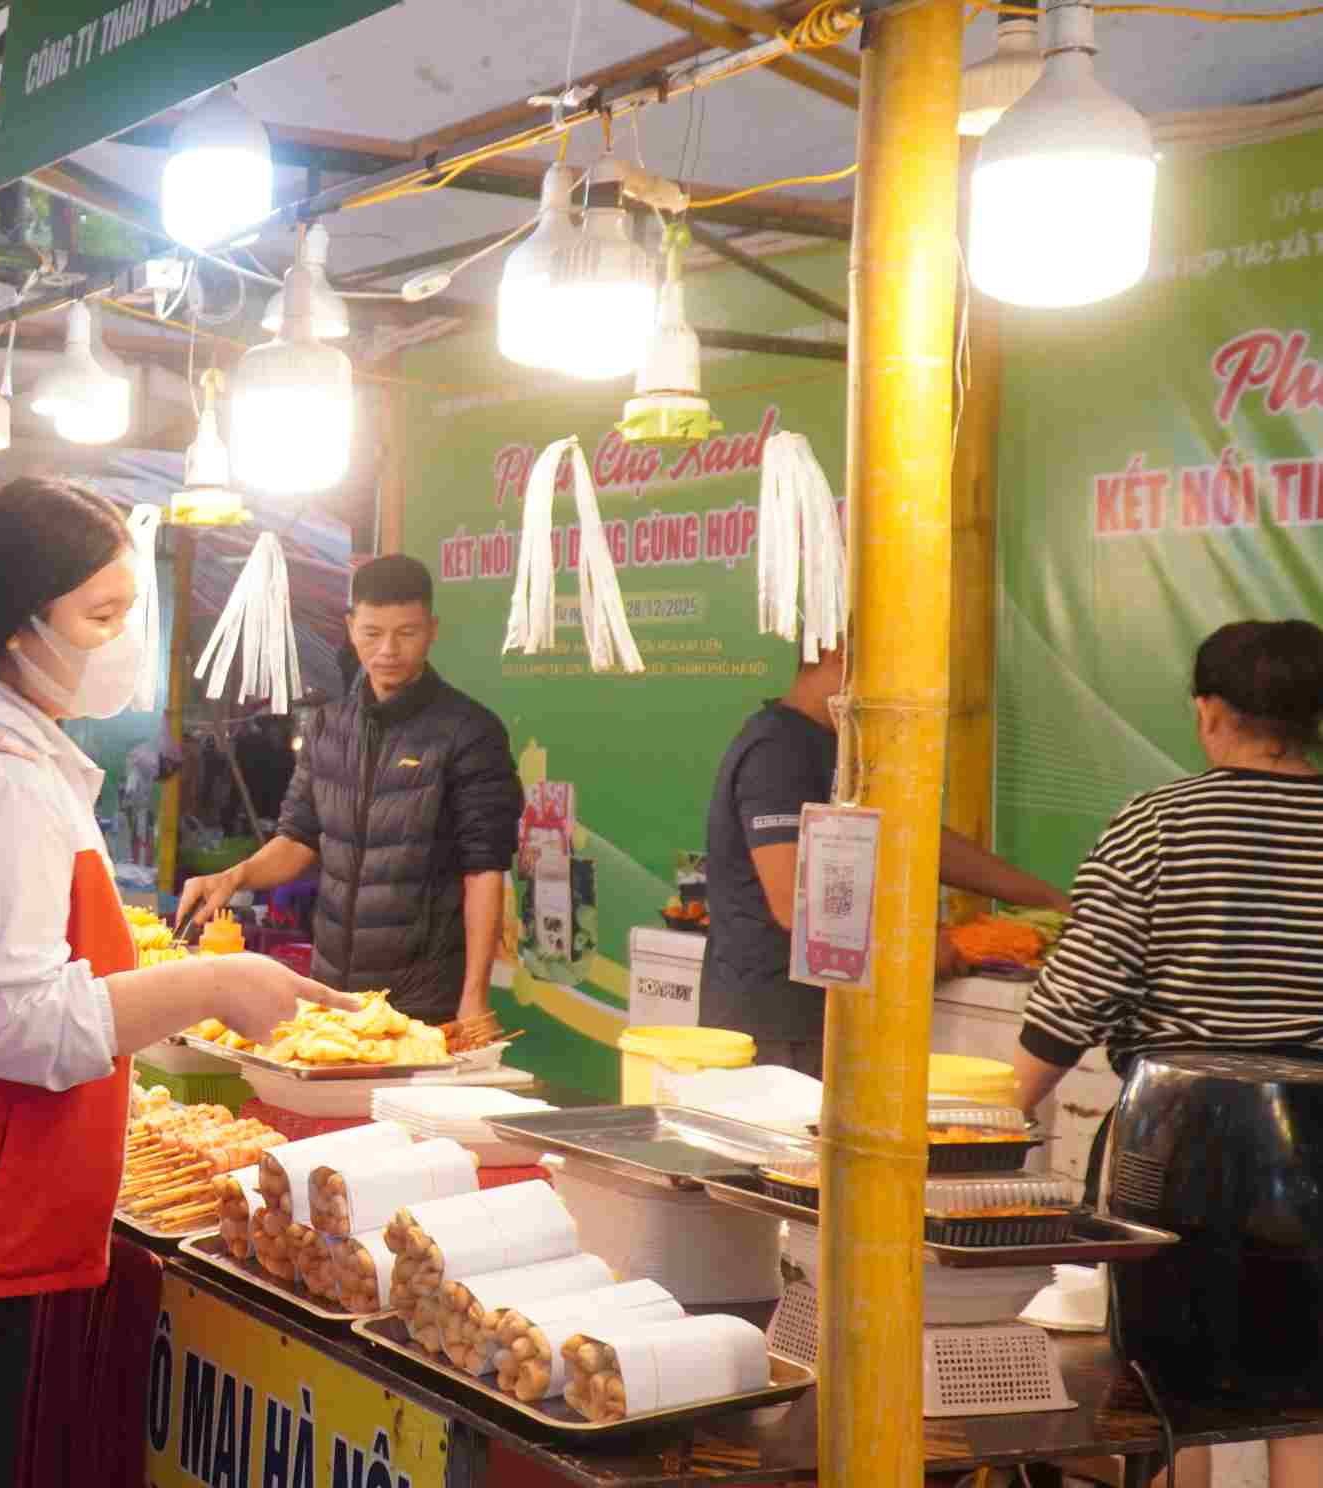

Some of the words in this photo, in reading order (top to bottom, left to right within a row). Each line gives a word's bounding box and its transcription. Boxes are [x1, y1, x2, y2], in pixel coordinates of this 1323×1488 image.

[24, 34, 71, 95] CÔNG
[76, 21, 98, 68] TY
[99, 1, 149, 55] TNHH
[1095, 451, 1169, 535] KẾT
[1179, 447, 1257, 529] NỐI
[1269, 462, 1323, 526] TI
[442, 527, 475, 577] KẾT
[633, 510, 698, 562] CÙNG
[706, 502, 757, 568] HỢP
[179, 1350, 254, 1488] MAI
[262, 1386, 315, 1488] HÀ
